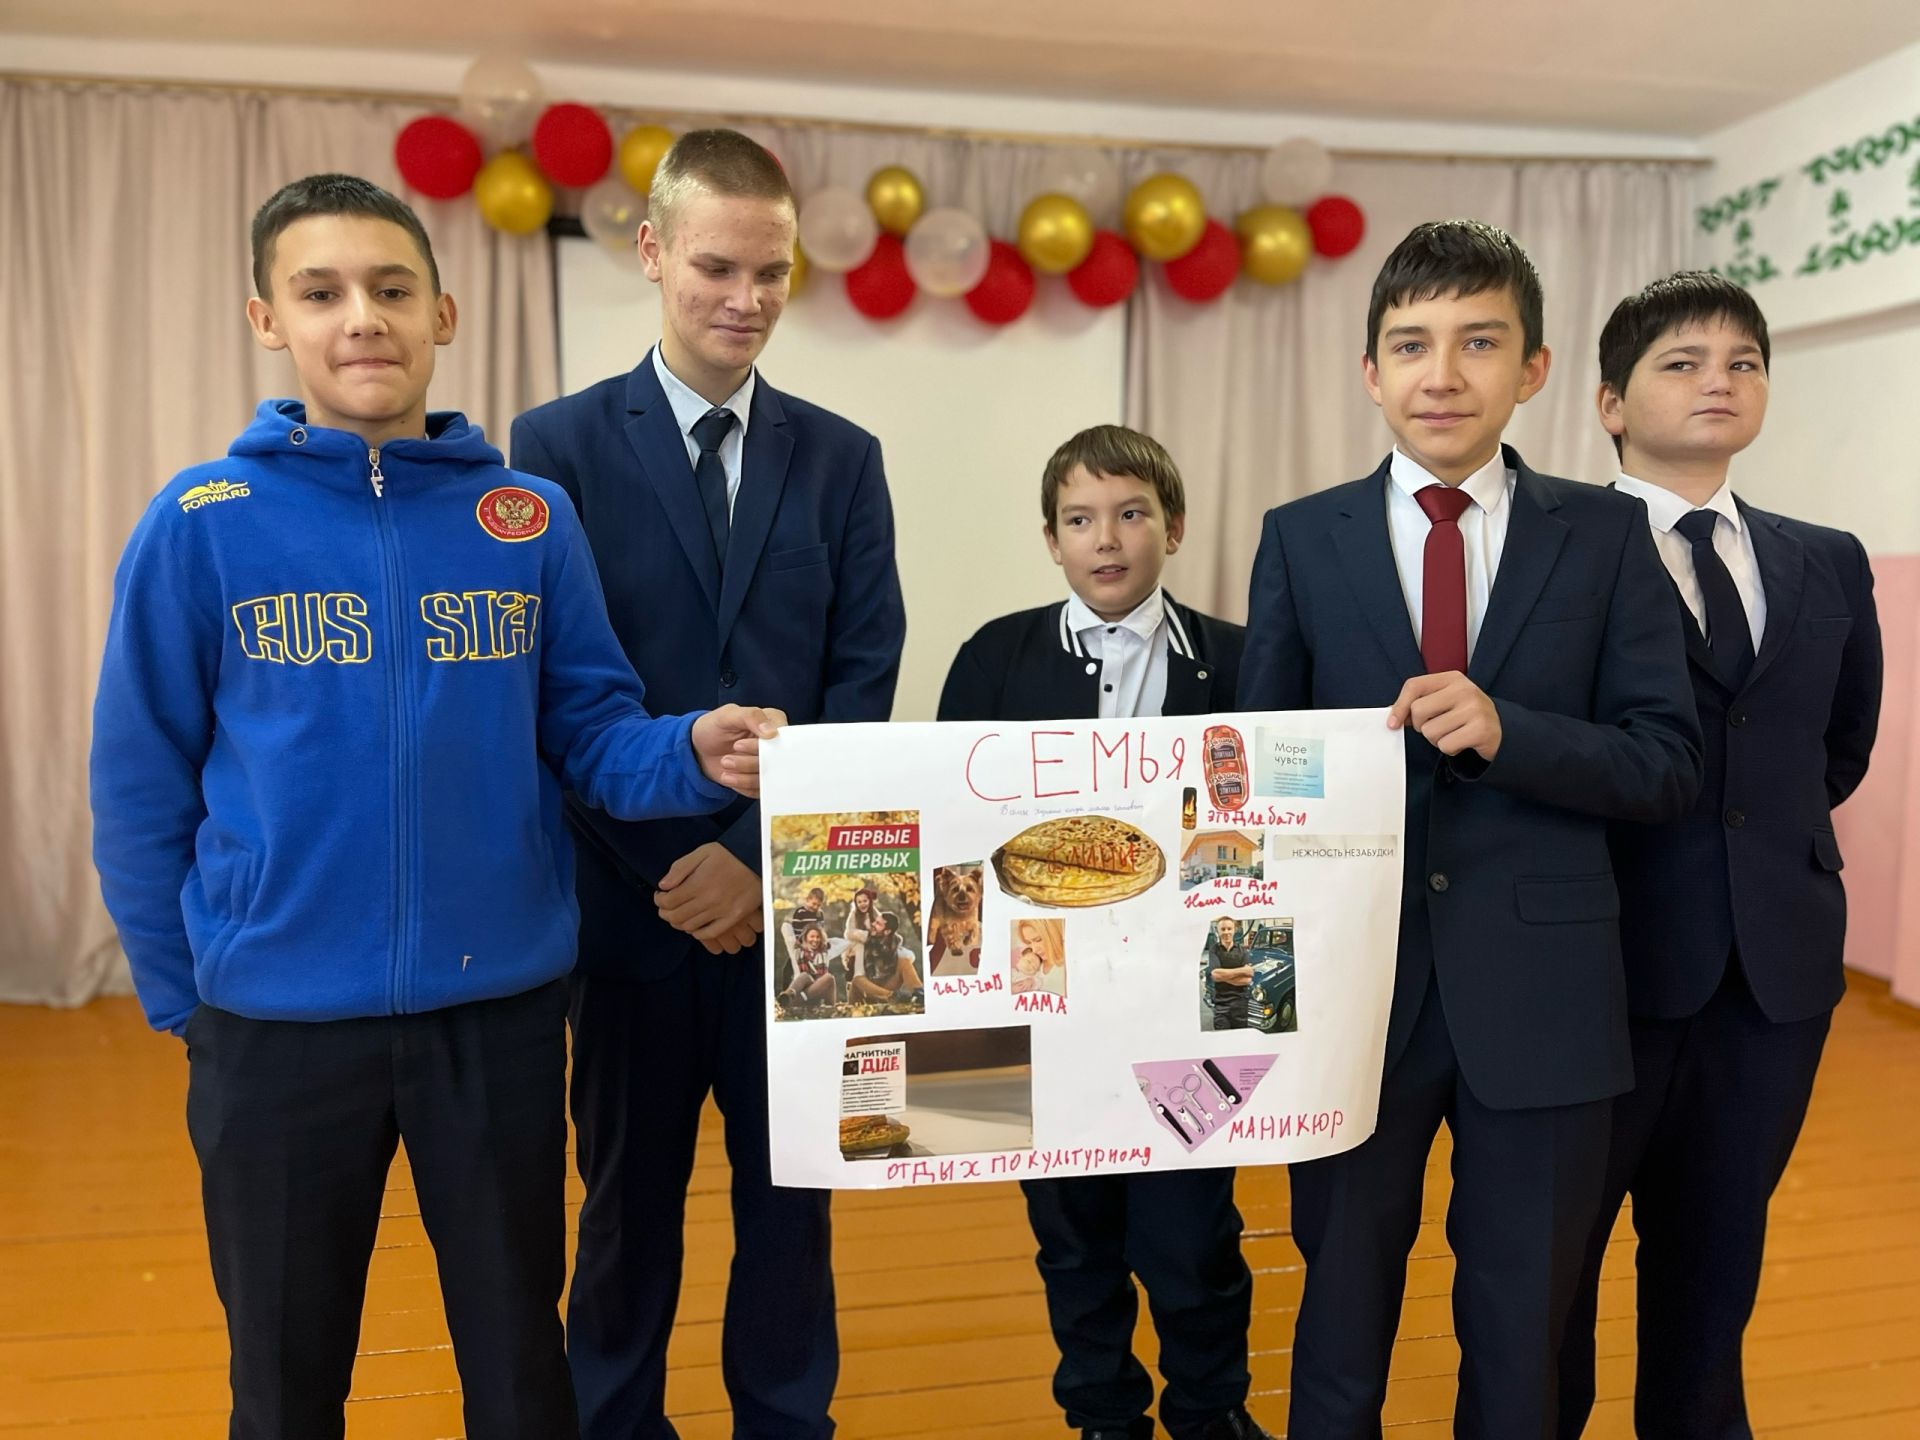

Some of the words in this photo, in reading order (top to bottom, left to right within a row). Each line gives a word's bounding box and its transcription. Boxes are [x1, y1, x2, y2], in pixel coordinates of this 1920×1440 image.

[182, 487, 251, 513] FORWARD
[1274, 742, 1307, 756] Море
[966, 730, 1186, 801] СЕМЬЯ
[1274, 756, 1308, 767] чувств
[837, 829, 911, 846] ПЕРВЫЕ
[793, 855, 831, 872] ДЛЯ
[836, 852, 910, 870] ПЕРВЫХ
[1292, 848, 1343, 857] НЕЖНОСТЬ
[1344, 848, 1394, 857] НЕЗАБУДКИ
[1015, 993, 1067, 1015] МАМА
[1229, 1110, 1344, 1143] МАНИКЮР
[887, 1160, 981, 1184] ОТДЫХ
